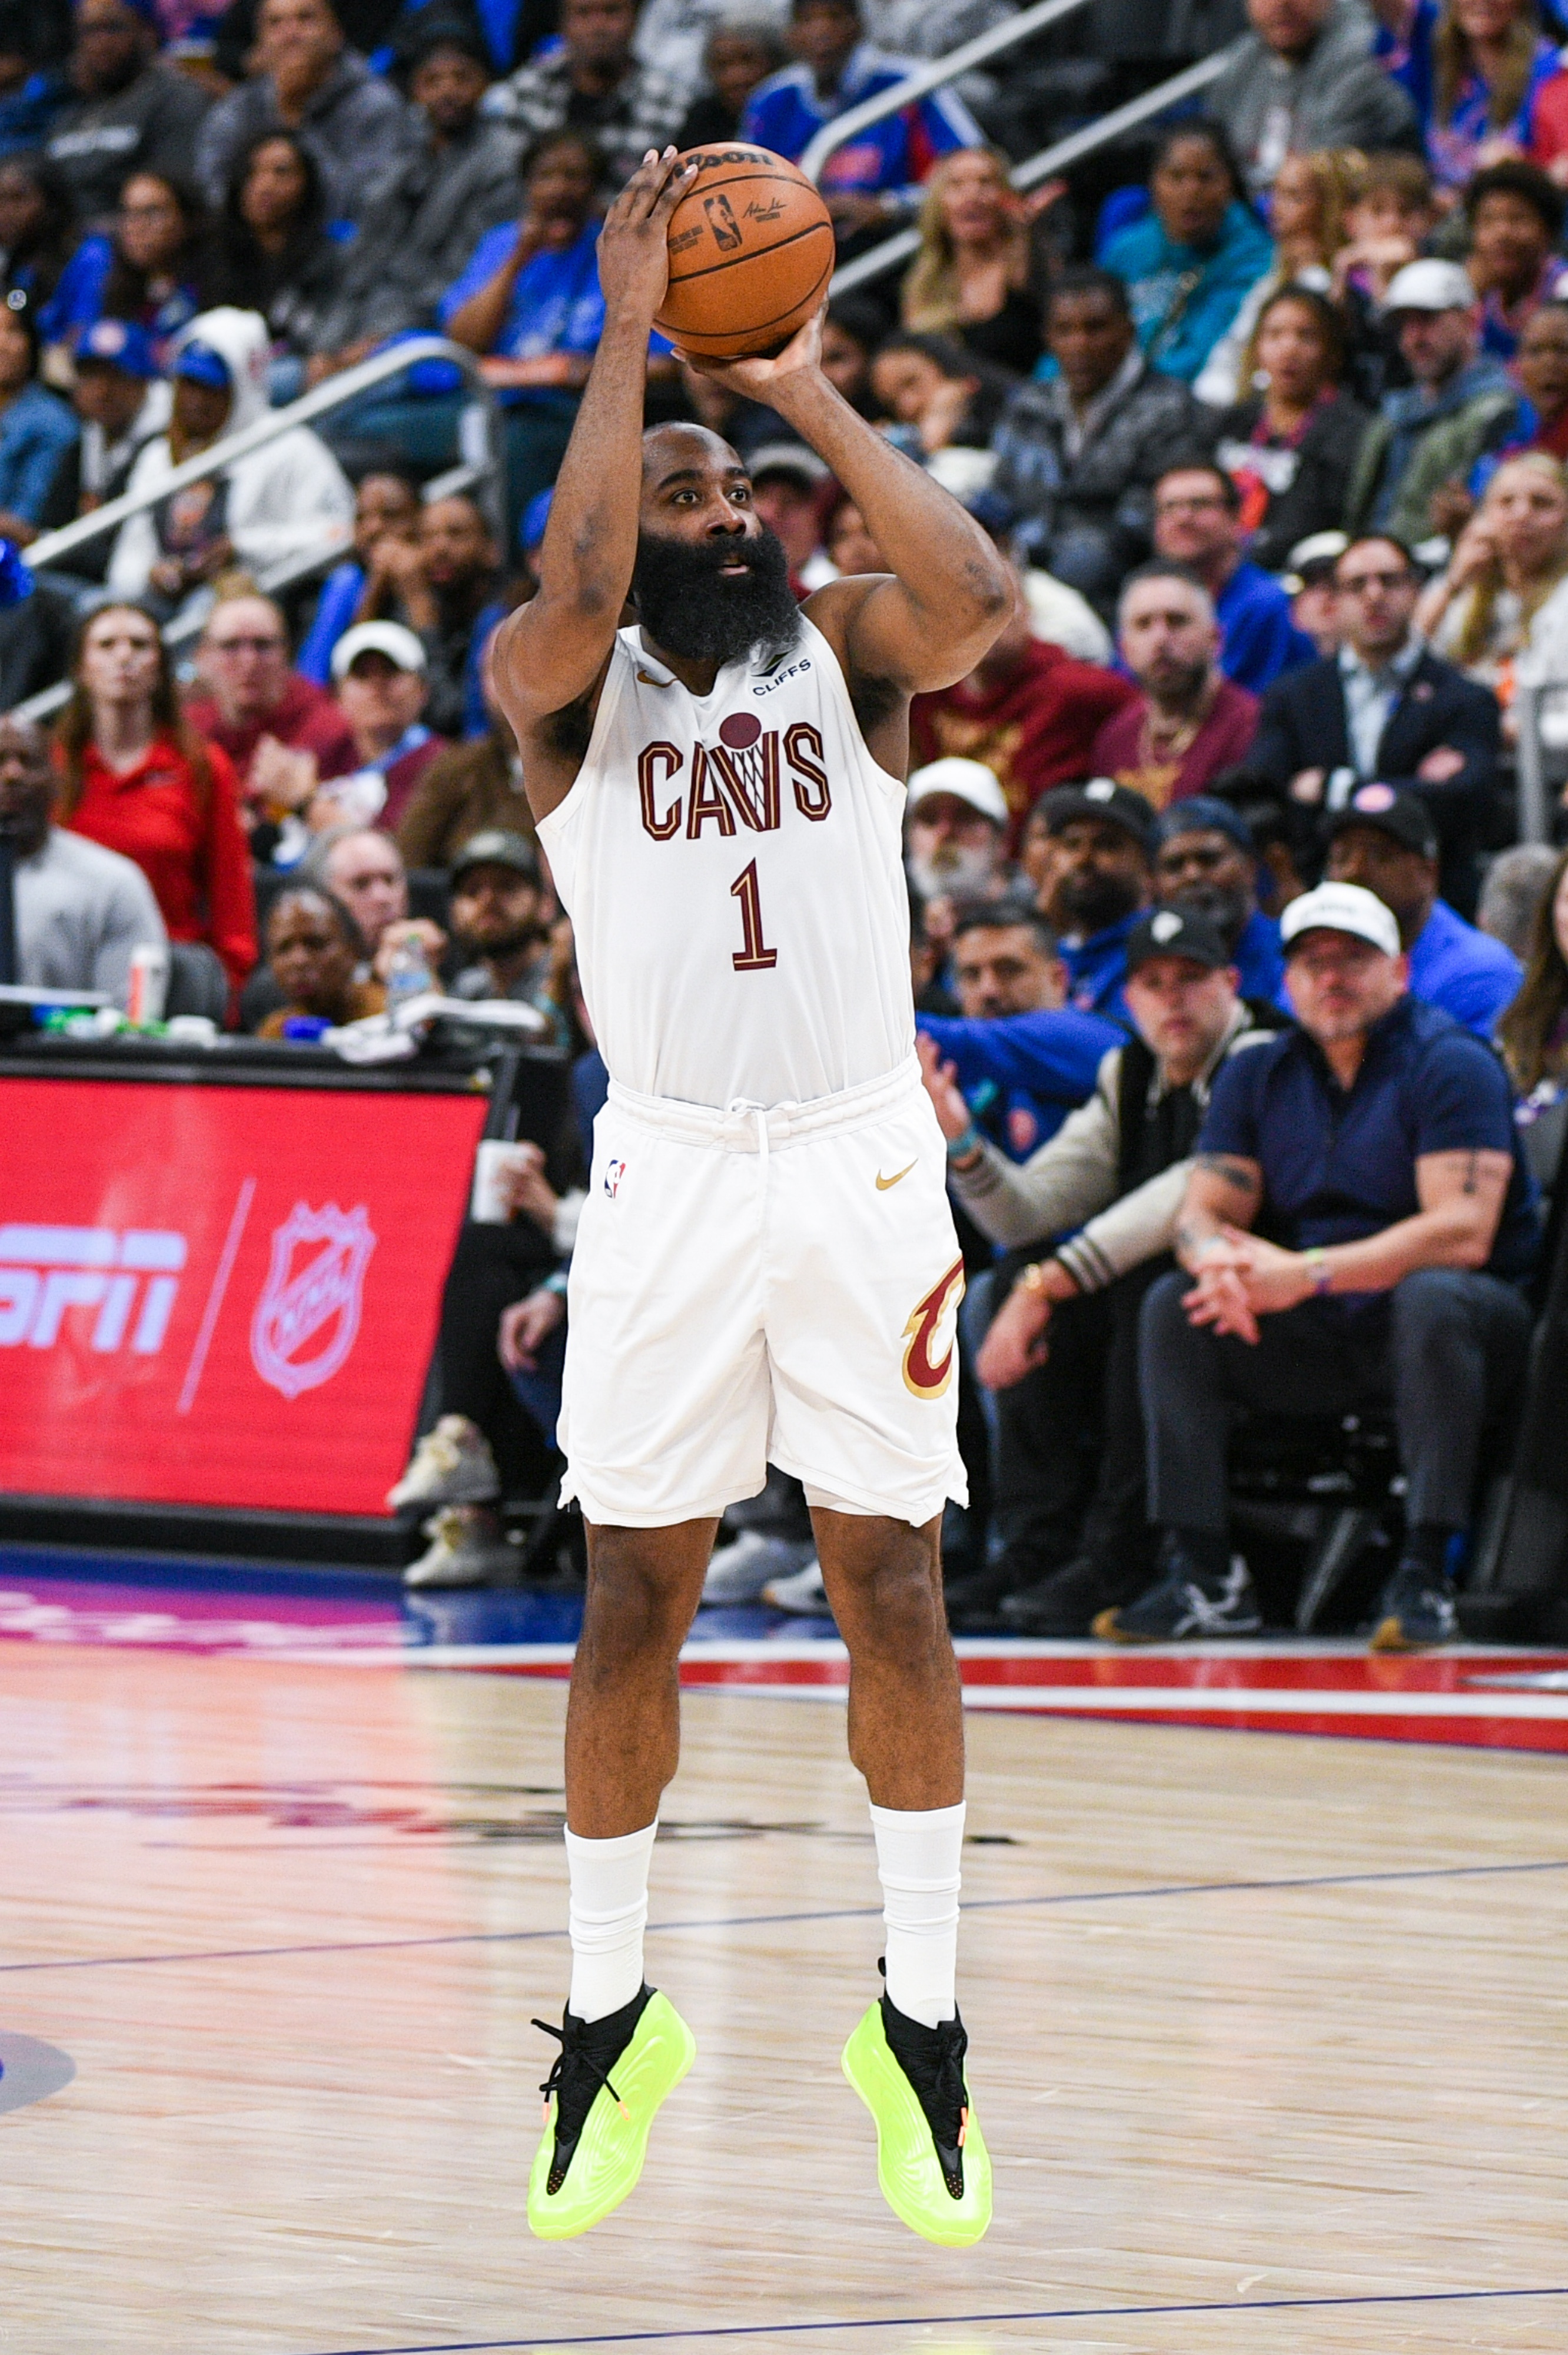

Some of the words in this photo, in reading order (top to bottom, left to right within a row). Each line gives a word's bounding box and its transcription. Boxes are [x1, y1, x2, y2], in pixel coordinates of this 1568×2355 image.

[753, 659, 811, 696] CLIFFS
[638, 722, 832, 841] CAVS
[730, 857, 777, 971] 1
[0, 1223, 187, 1354] SPN
